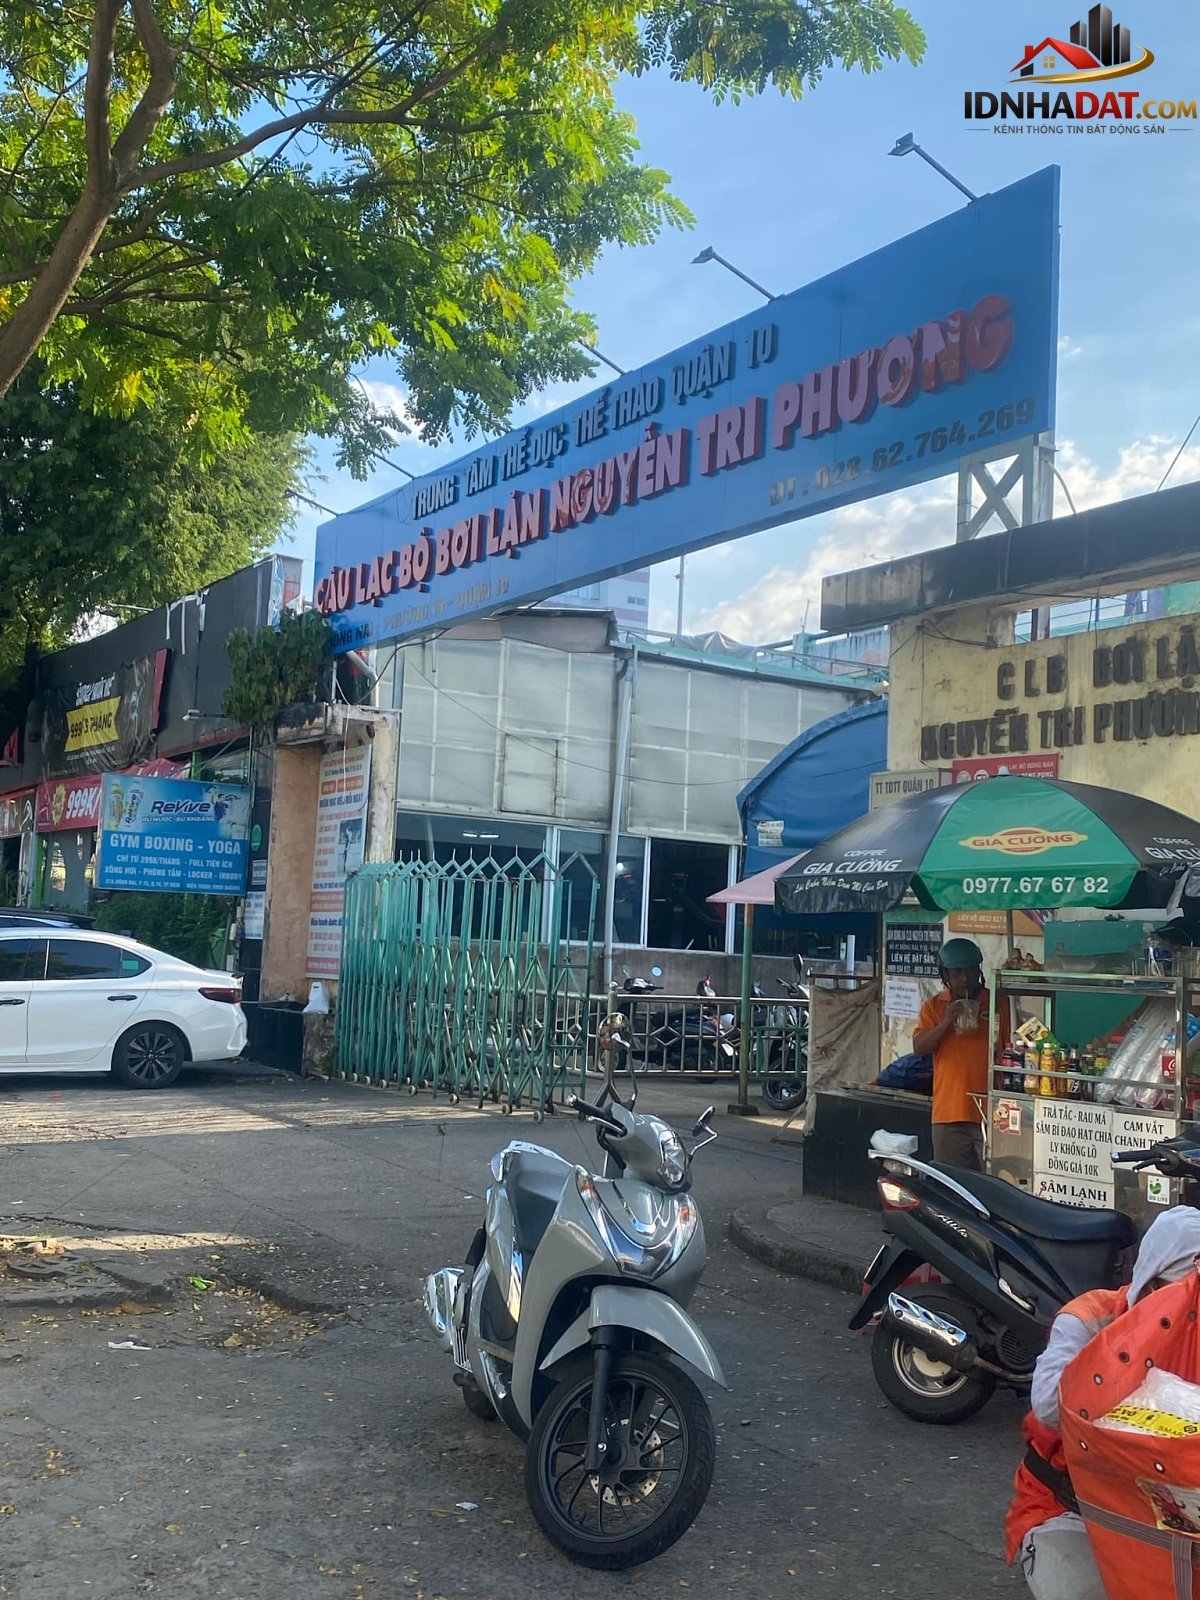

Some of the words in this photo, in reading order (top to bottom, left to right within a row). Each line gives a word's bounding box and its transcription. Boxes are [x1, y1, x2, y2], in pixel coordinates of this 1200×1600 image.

[412, 475, 457, 520] TRUNG
[464, 455, 497, 496] TÂM
[610, 377, 664, 430] THAO
[671, 341, 736, 405] QUẬN
[355, 551, 400, 607] LẠC
[399, 527, 436, 593] BỘ
[435, 514, 486, 575] BƠI
[548, 421, 692, 533] NGUYỄN
[697, 397, 768, 476] TRI
[772, 294, 1014, 449] PHƯƠNG
[996, 653, 1067, 700] CLB
[1037, 705, 1086, 749] TRI
[875, 782, 883, 794] TT
[110, 833, 140, 849] GYM
[144, 836, 194, 852] BOXING
[208, 840, 241, 855] YOGA
[971, 836, 1004, 847] GIA
[189, 858, 204, 867] FULL
[1144, 847, 1183, 860] GIA
[803, 861, 834, 875] GIA
[962, 877, 1044, 894] 0977.67
[1051, 876, 1076, 893] 67
[1083, 876, 1109, 893] 82
[1043, 1105, 1057, 1119] TRÀ
[1059, 1105, 1073, 1120] TẮC
[1078, 1111, 1093, 1124] RAU
[1095, 1111, 1106, 1126] MÁ
[1061, 1126, 1077, 1139] ĐAO
[1077, 1128, 1093, 1143] HẠT
[1094, 1130, 1113, 1144] CHIA
[1123, 1120, 1144, 1133] CAM
[1050, 1141, 1060, 1153] LY
[1114, 1135, 1146, 1149] CHANH
[1048, 1156, 1069, 1172] ĐỒNG
[1070, 1161, 1083, 1174] GIÁ
[1085, 1164, 1099, 1177] 10K
[1040, 1180, 1067, 1196] SÂM
[1071, 1185, 1108, 1202] LẠNH
